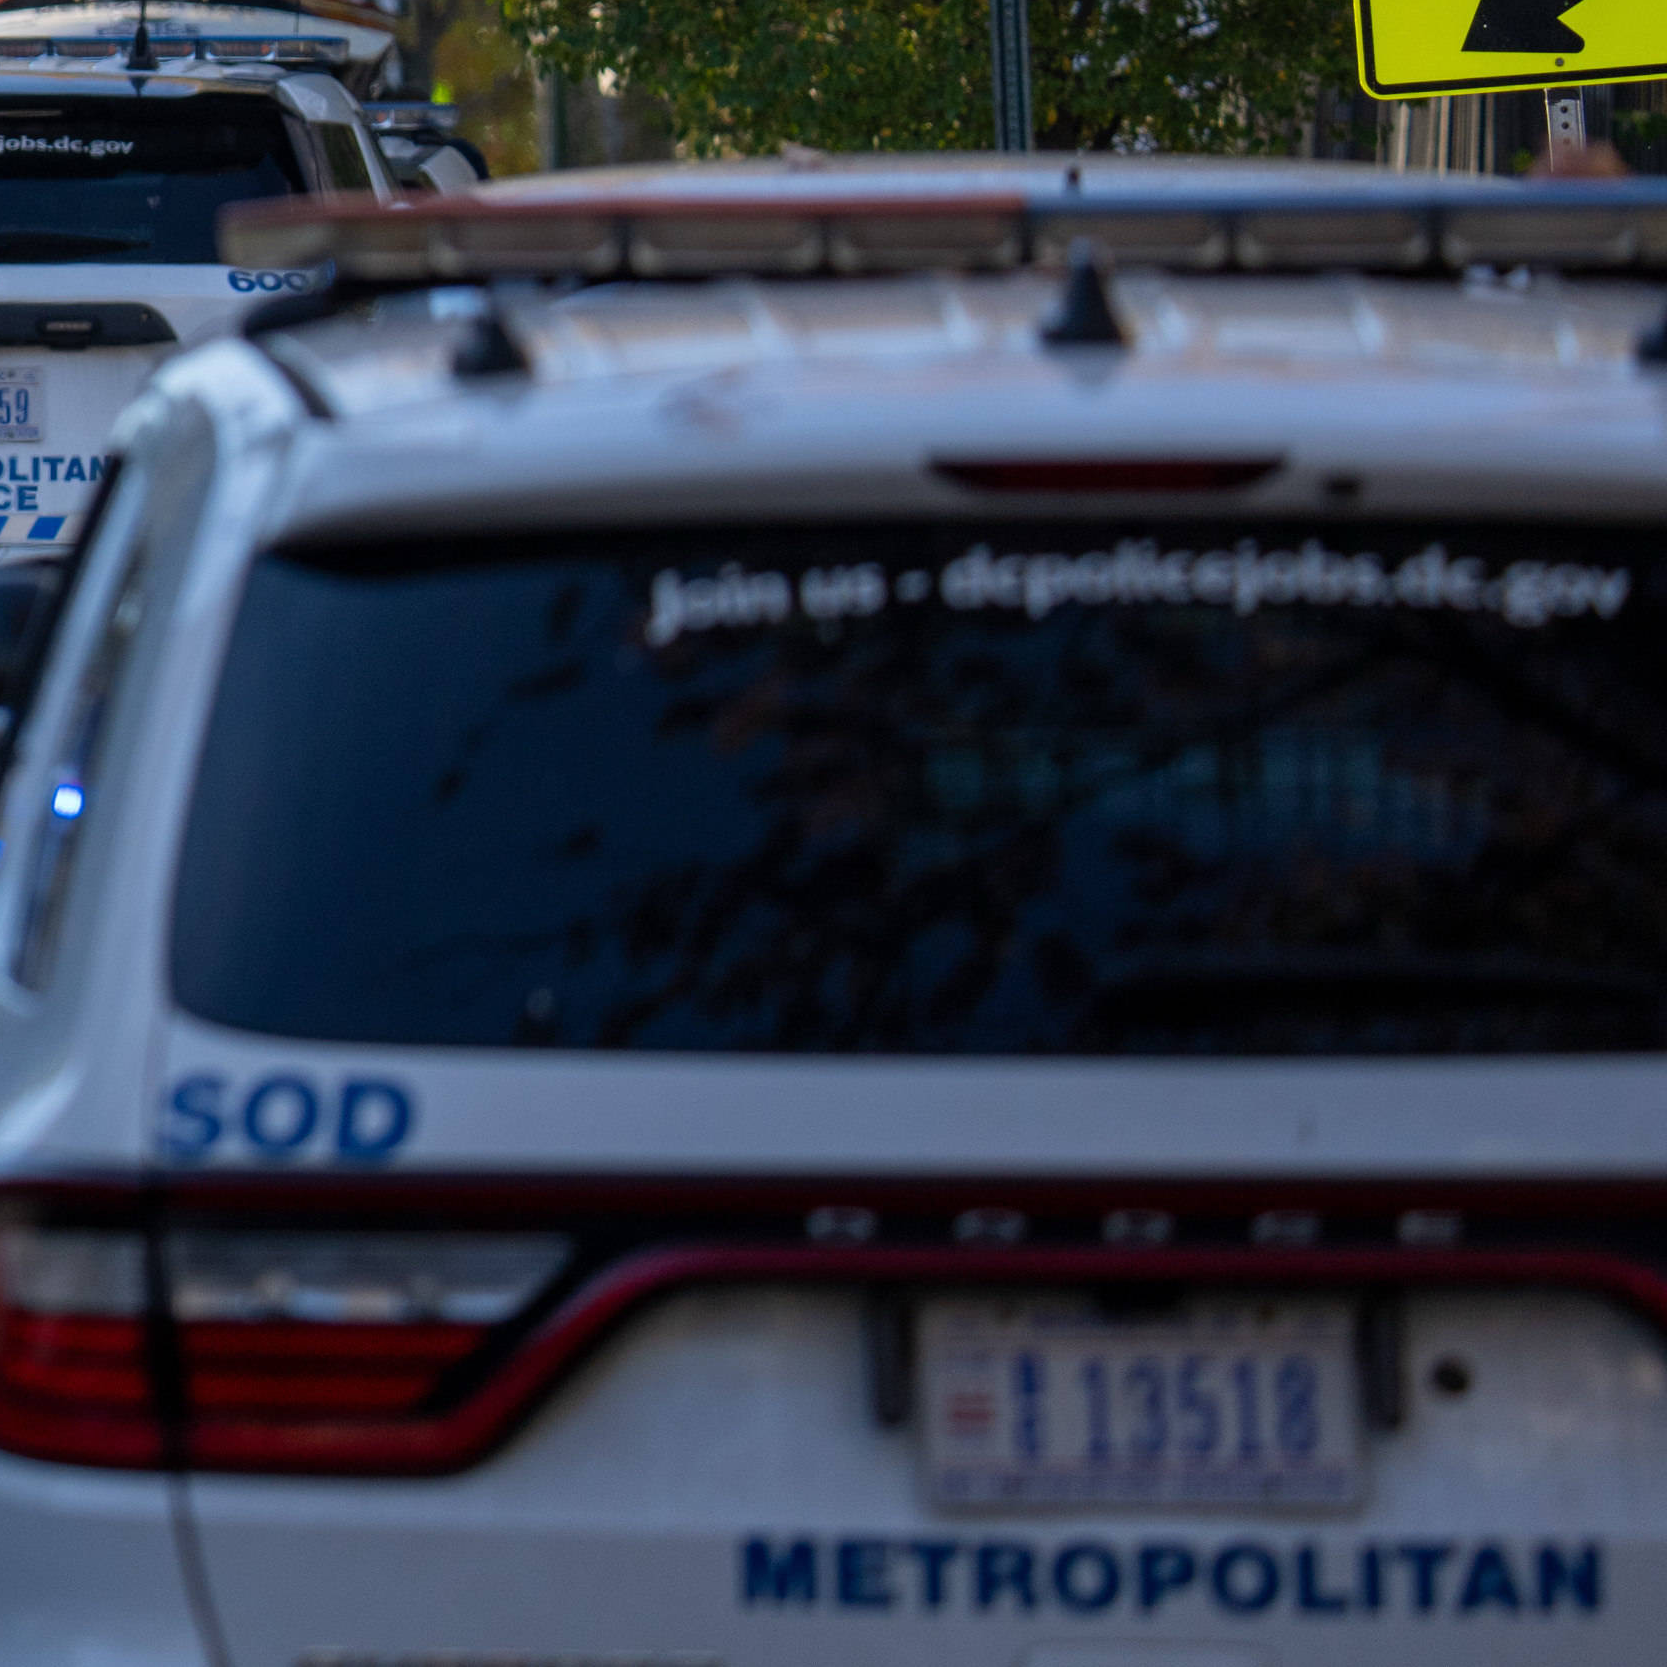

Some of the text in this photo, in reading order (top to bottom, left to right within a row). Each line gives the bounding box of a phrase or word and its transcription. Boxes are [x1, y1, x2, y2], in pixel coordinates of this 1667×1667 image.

[646, 564, 792, 647] Join
[801, 565, 885, 618] us
[940, 538, 1631, 627] dcpolicejobs.dc.gov
[164, 1074, 414, 1161] SOD
[742, 1536, 1603, 1615] METROPOLITAN
